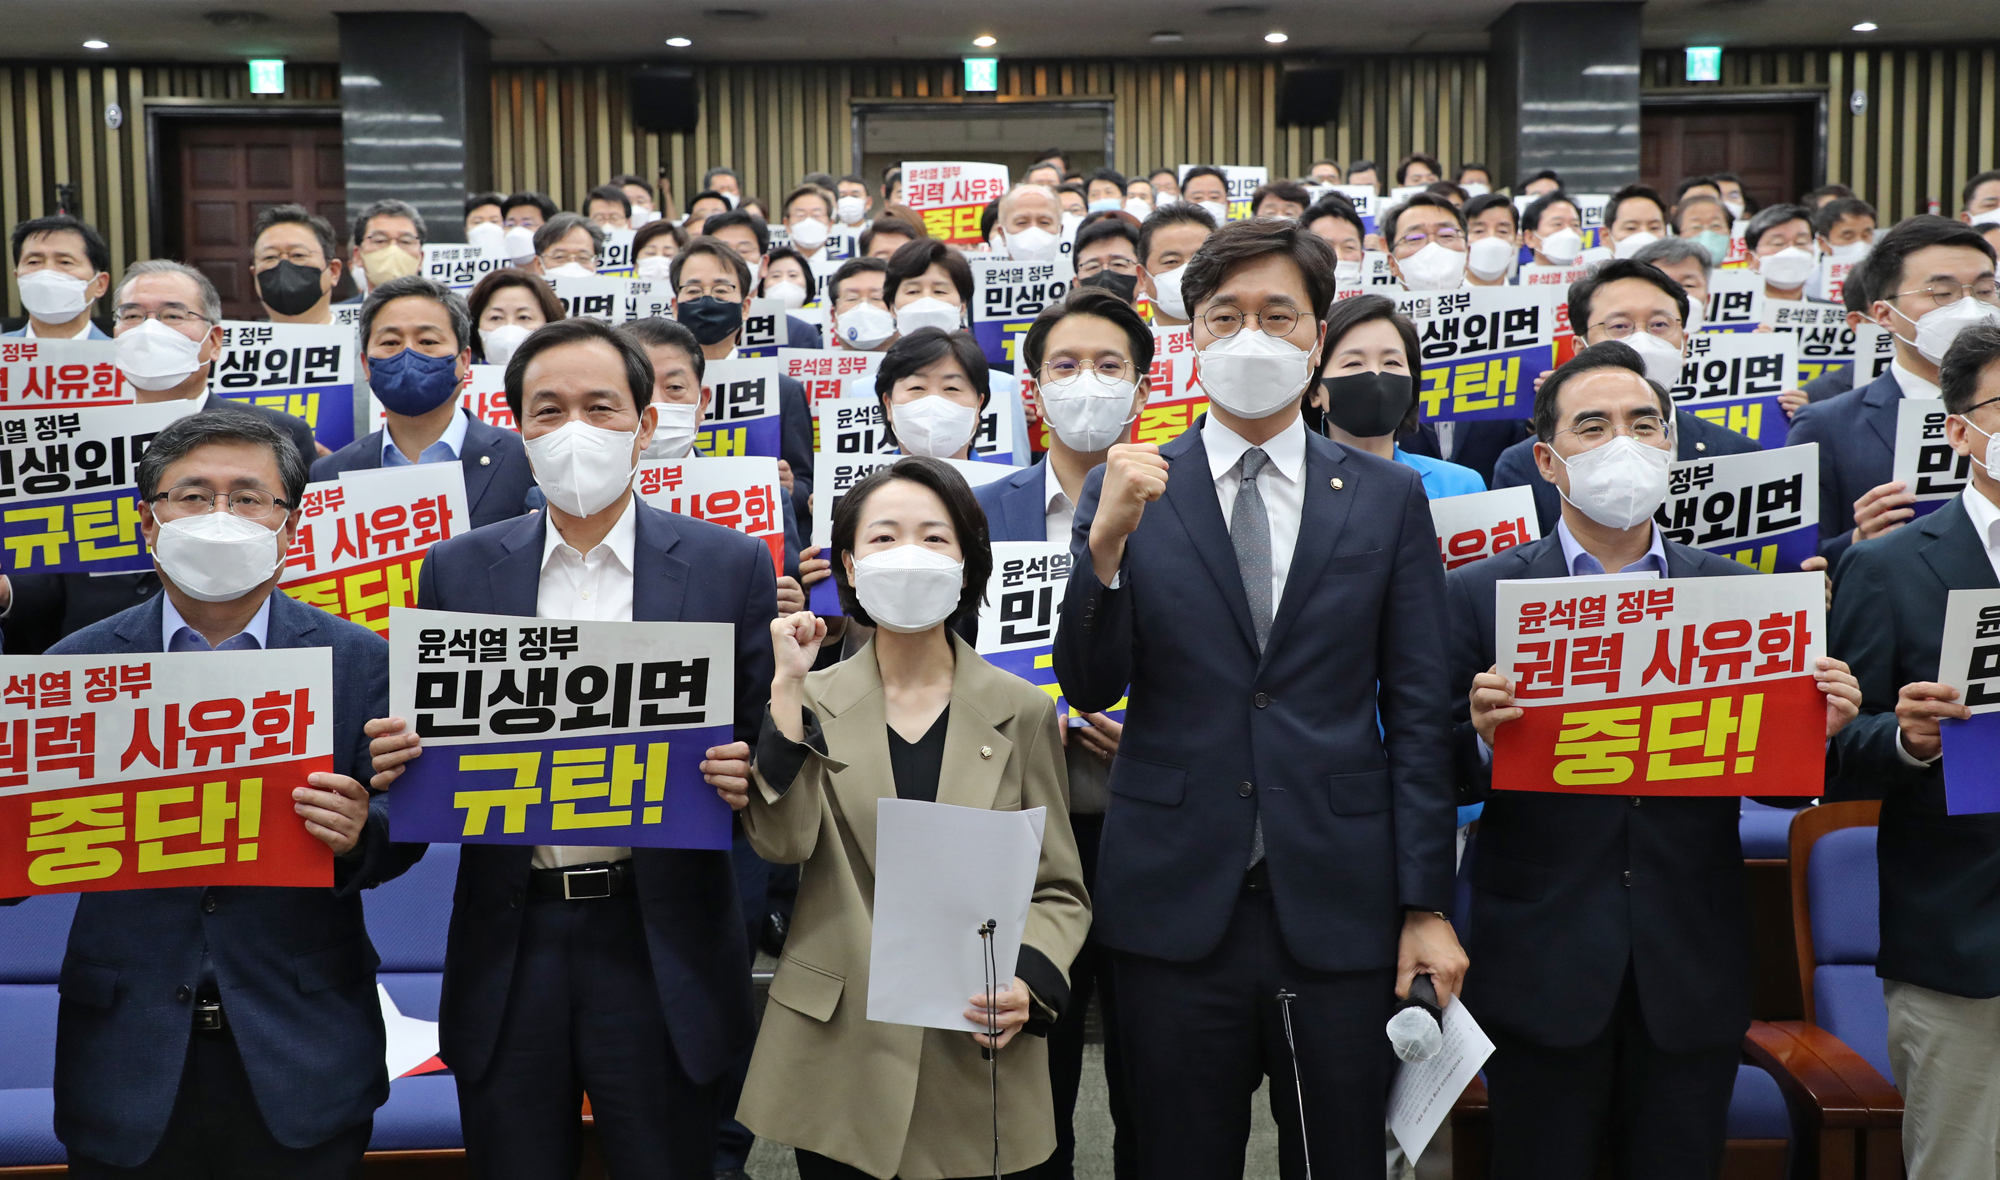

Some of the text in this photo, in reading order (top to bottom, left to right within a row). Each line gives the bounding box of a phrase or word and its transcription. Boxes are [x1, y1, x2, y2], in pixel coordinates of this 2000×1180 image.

[908, 178, 1004, 207] 권력 사유화
[1028, 265, 1054, 281] 정부
[1437, 292, 1471, 316] 정부
[2, 343, 38, 362] 정부
[239, 327, 272, 347] 정부
[788, 356, 867, 377] 윤석열 정부
[34, 413, 81, 442] 정부
[640, 466, 683, 495] 정부
[1670, 463, 1714, 496] 정부
[303, 486, 345, 518] 정부
[332, 494, 453, 564] 사유화
[1518, 587, 1675, 635] 윤석열 정부
[417, 625, 579, 664] 윤석열 정부
[1513, 610, 1812, 700] 권력 사유화
[0, 662, 152, 710] 석열 정부
[415, 656, 711, 740] 민생외면
[120, 687, 316, 773] 사유화
[1552, 692, 1765, 786] 중단!
[453, 742, 670, 837] 규탄!
[26, 777, 264, 887] 중단!
